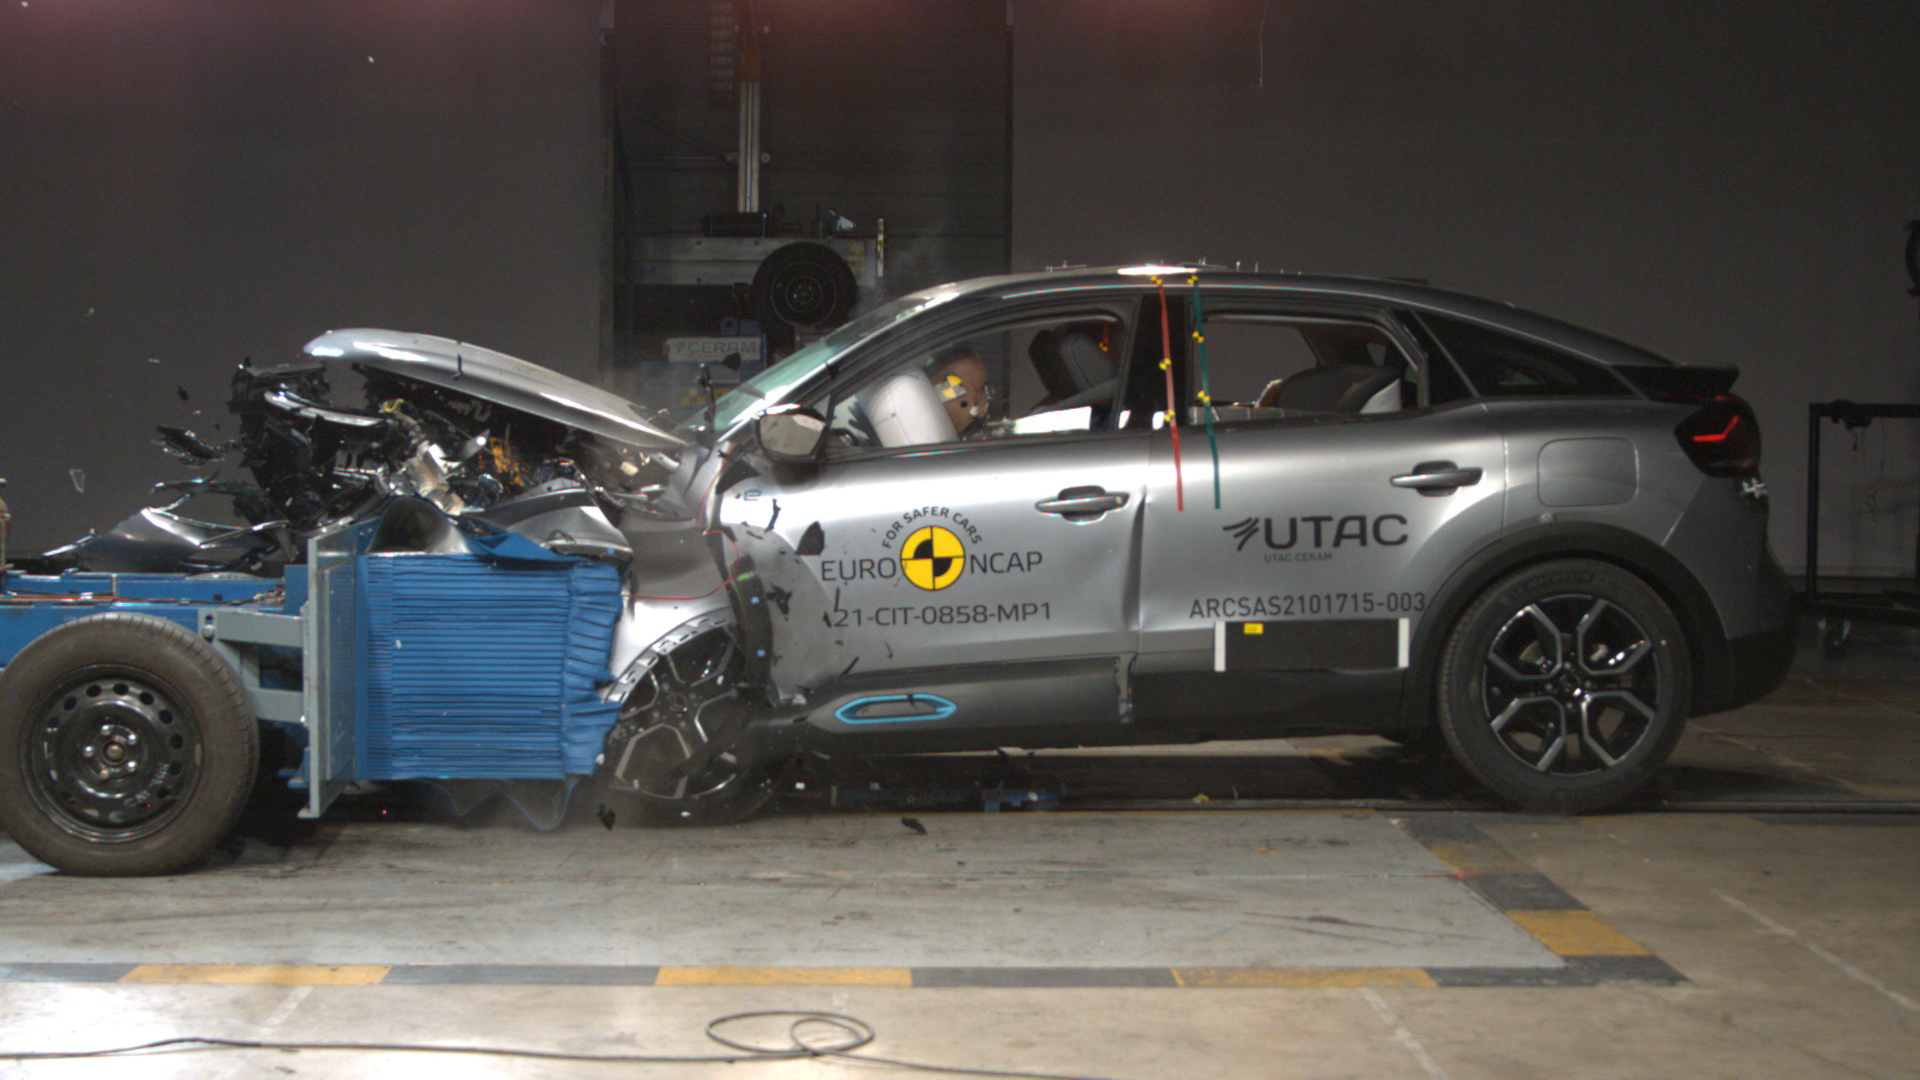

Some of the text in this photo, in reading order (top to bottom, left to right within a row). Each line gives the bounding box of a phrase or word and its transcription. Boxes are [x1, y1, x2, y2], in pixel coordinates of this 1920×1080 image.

[688, 341, 757, 354] CERAM
[882, 506, 983, 549] FOR SAFER CARS
[1264, 513, 1409, 550] UTAC
[821, 551, 1043, 581] EURO NCAP
[1264, 552, 1333, 563] UTAC CERAM
[834, 602, 1051, 628] 21-CIT-0858-MP1
[1189, 592, 1426, 619] ARCSAS2101715-003
